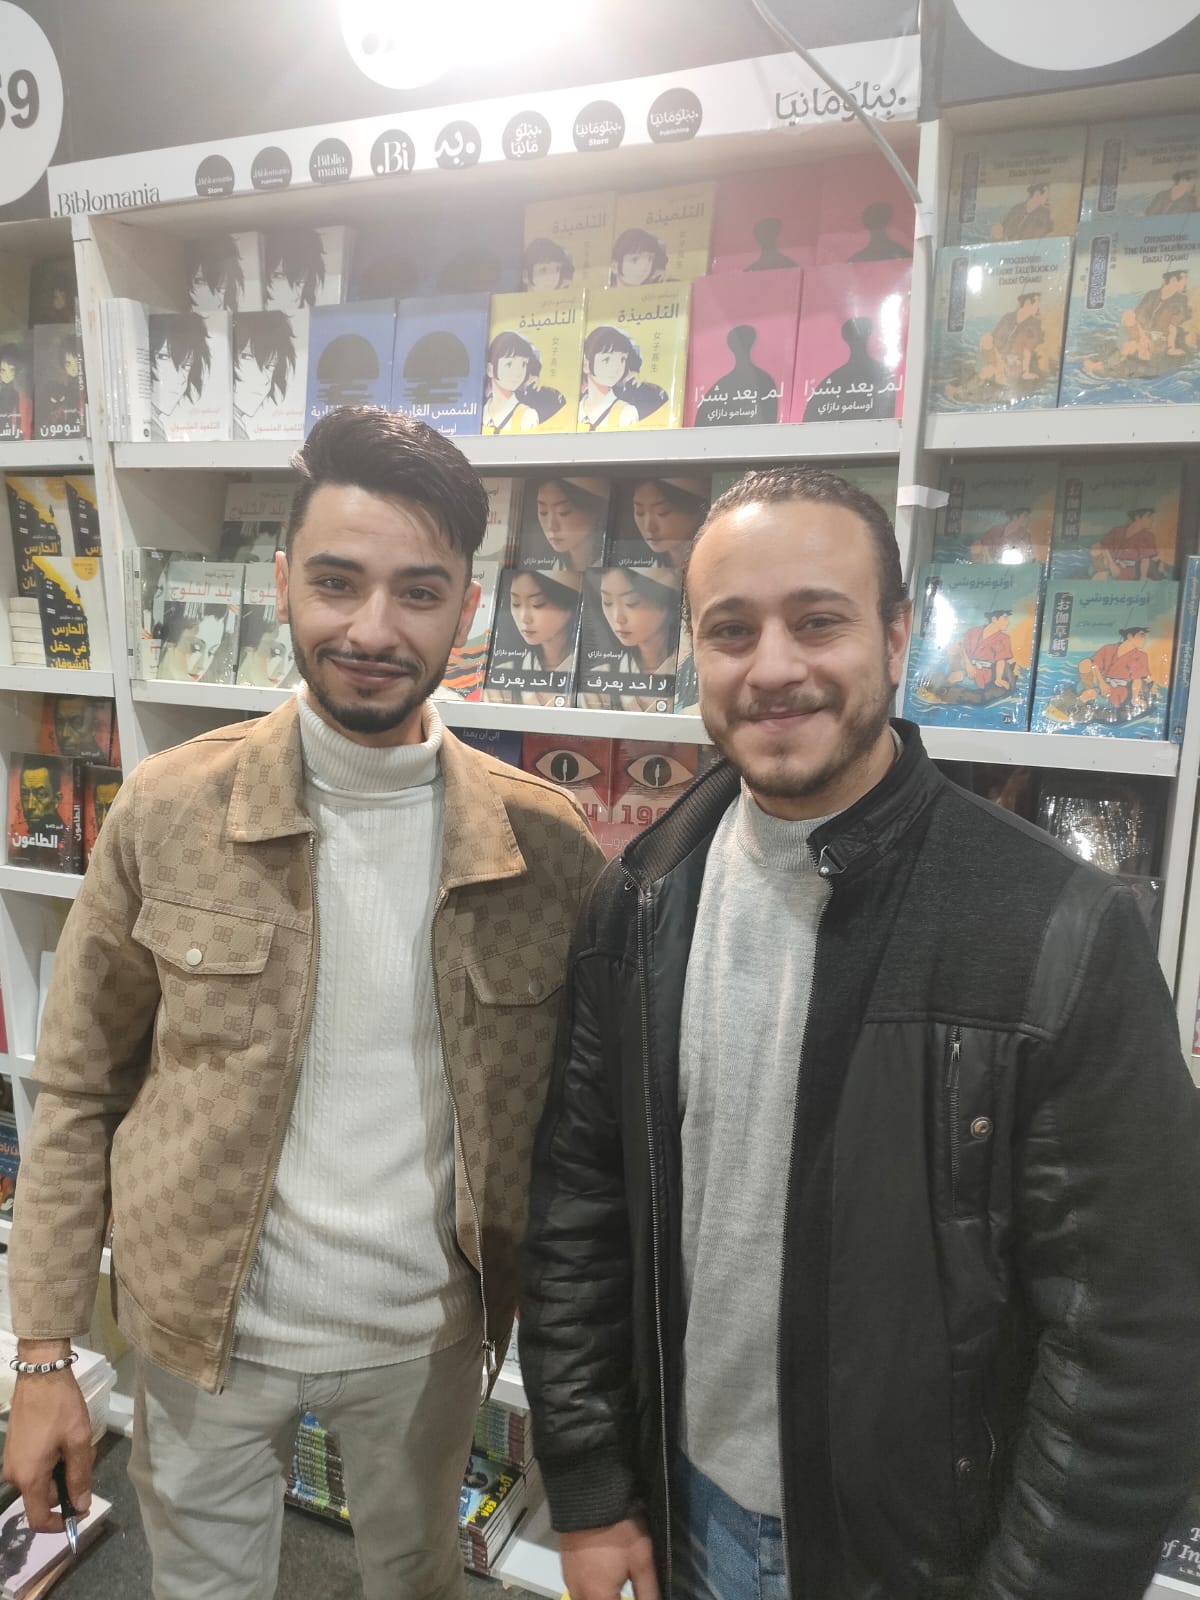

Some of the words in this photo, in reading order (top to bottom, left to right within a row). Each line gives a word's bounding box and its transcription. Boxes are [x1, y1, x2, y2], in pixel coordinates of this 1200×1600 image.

[0, 69, 40, 130] 9
[519, 309, 576, 331] التلميذة
[618, 303, 679, 325] التلميذة
[762, 381, 784, 400] لم
[846, 380, 874, 397] يعد
[878, 375, 904, 394] لم
[732, 386, 758, 404] يعد
[431, 402, 477, 419] الشمس
[51, 622, 86, 637] الحارس
[50, 640, 71, 653] حقل
[72, 641, 87, 656] في
[490, 673, 525, 689] يعرف
[530, 672, 554, 687] أحد
[557, 674, 567, 687] لا
[586, 677, 623, 692] يعرف
[628, 676, 653, 690] أحد
[658, 677, 668, 690] لا
[620, 805, 668, 825] 19
[12, 832, 58, 848] الطاعون
[1178, 1544, 1200, 1563] In
